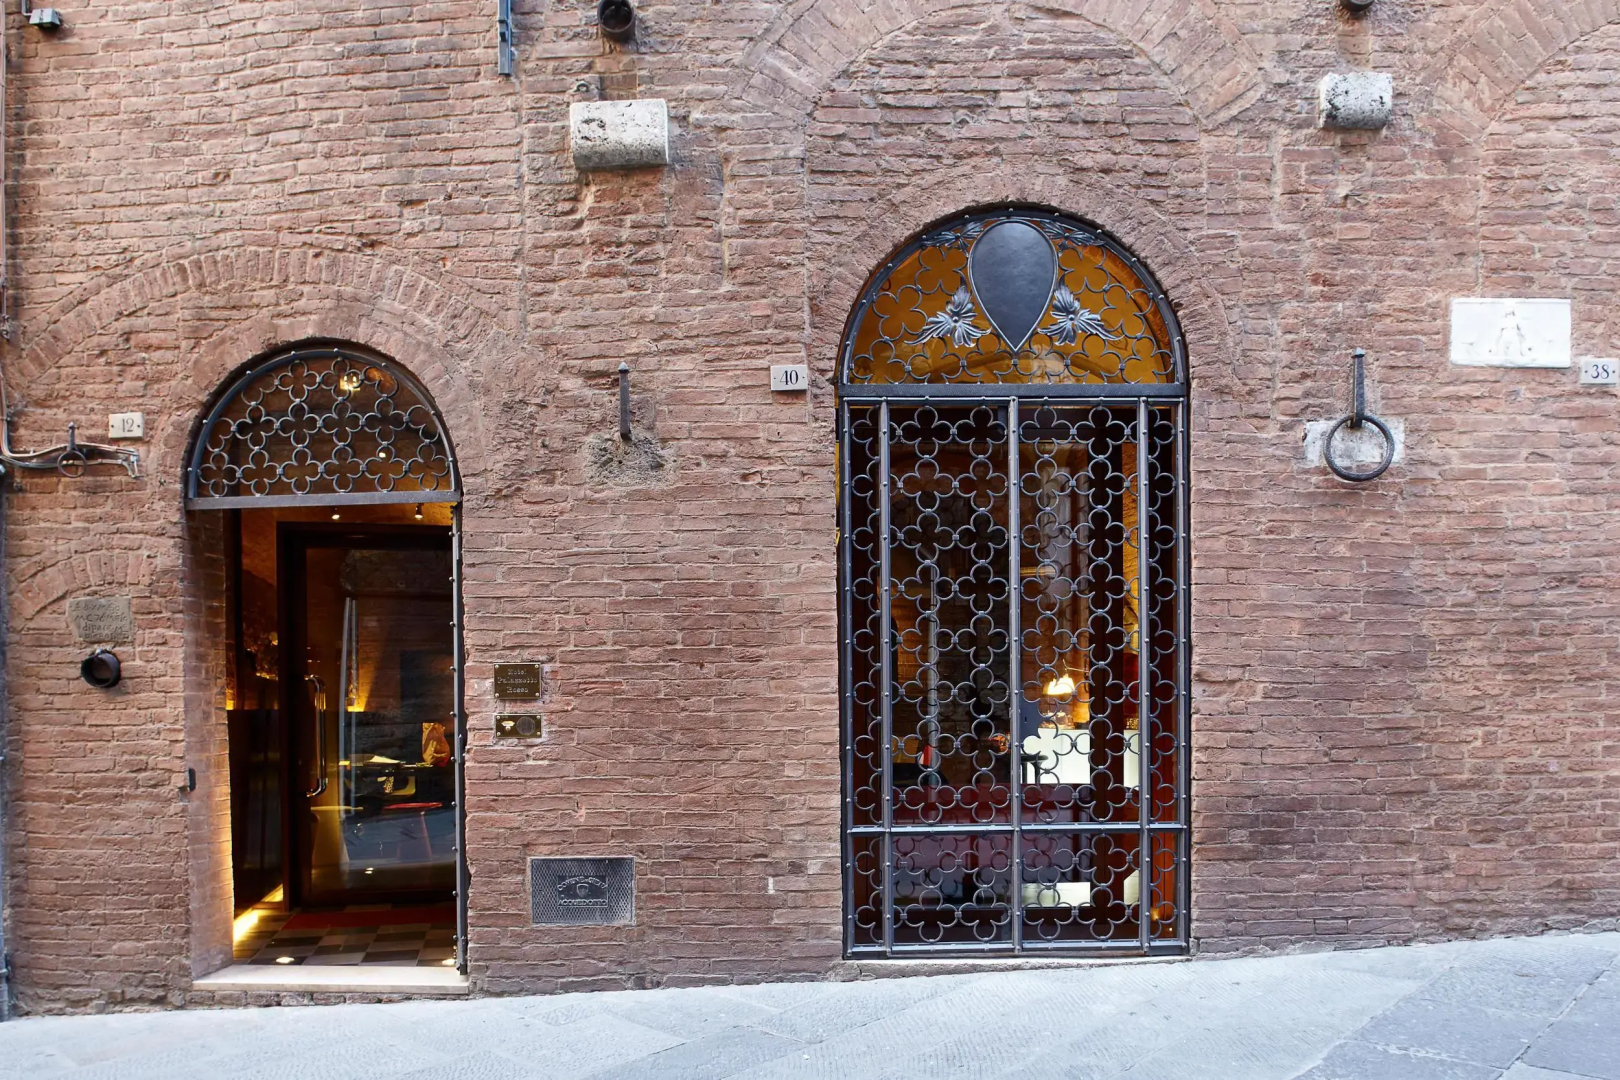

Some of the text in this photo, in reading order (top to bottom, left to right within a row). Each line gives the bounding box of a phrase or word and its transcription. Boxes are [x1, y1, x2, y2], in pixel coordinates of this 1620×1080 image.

[779, 369, 799, 386] 40
[1591, 364, 1610, 380] 38
[121, 418, 135, 433] 12
